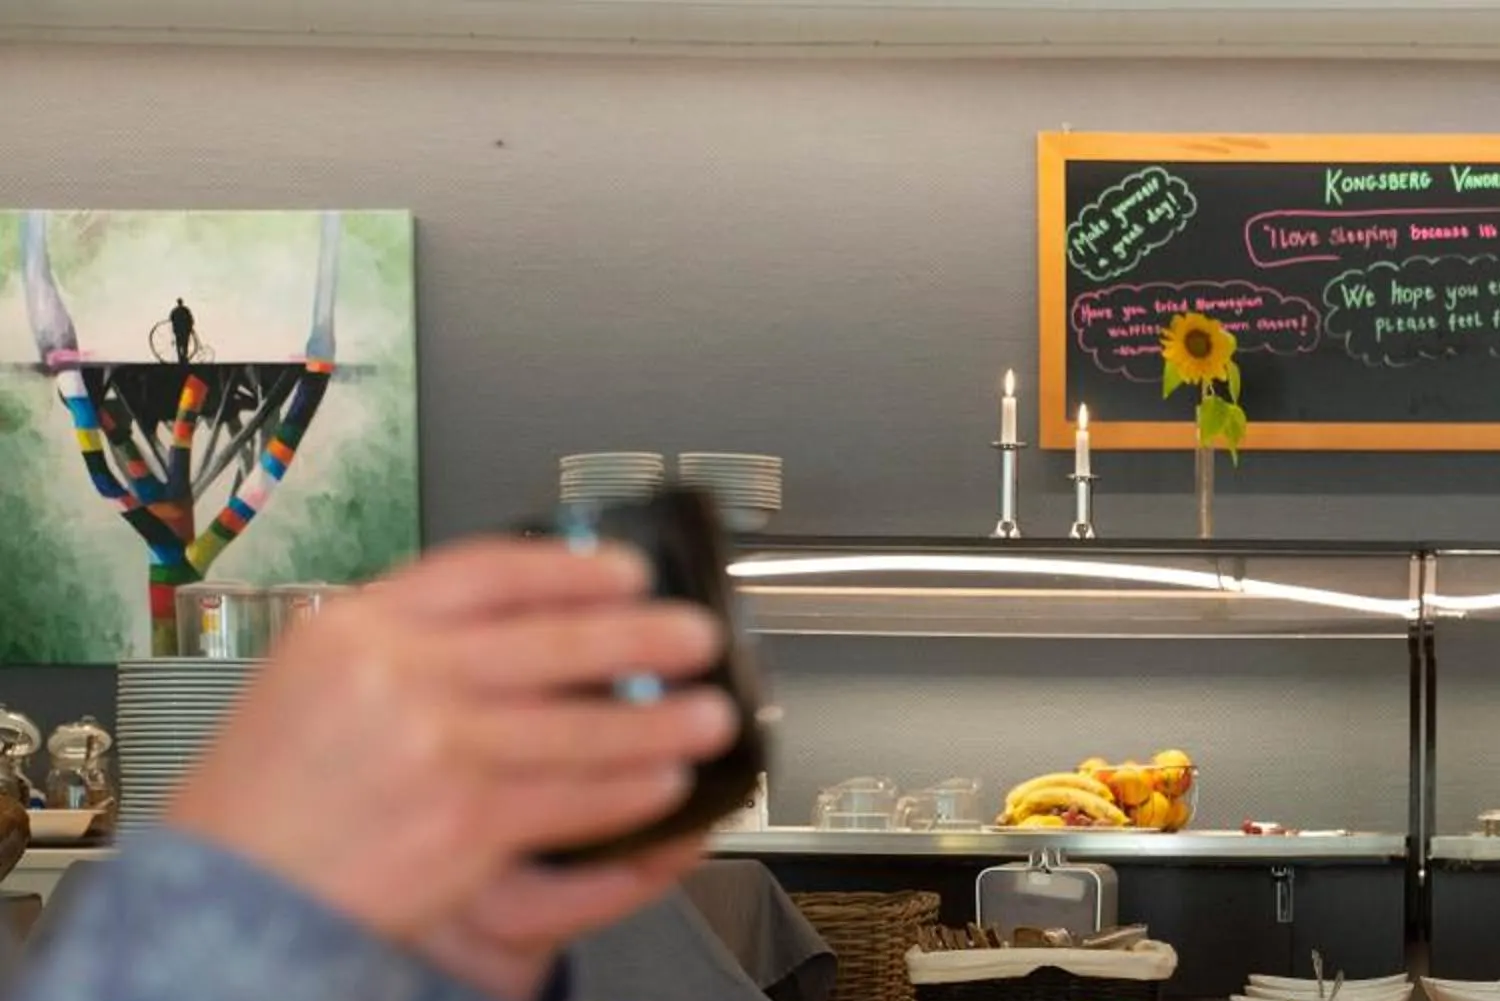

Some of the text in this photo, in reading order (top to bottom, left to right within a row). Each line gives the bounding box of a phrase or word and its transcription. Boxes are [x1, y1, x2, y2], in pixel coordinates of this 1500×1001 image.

[1325, 167, 1433, 206] KONGSBERG
[1072, 176, 1160, 256] Make yourself
[1112, 223, 1145, 260] great
[1146, 190, 1182, 224] day!
[1409, 222, 1470, 241] because
[1341, 283, 1376, 308] We
[1391, 279, 1436, 311] hope
[1445, 282, 1480, 311] you
[1080, 302, 1114, 328] Have
[1122, 305, 1148, 323] you
[1154, 297, 1190, 314] tried
[1374, 314, 1439, 344] please
[1448, 311, 1484, 333] feel
